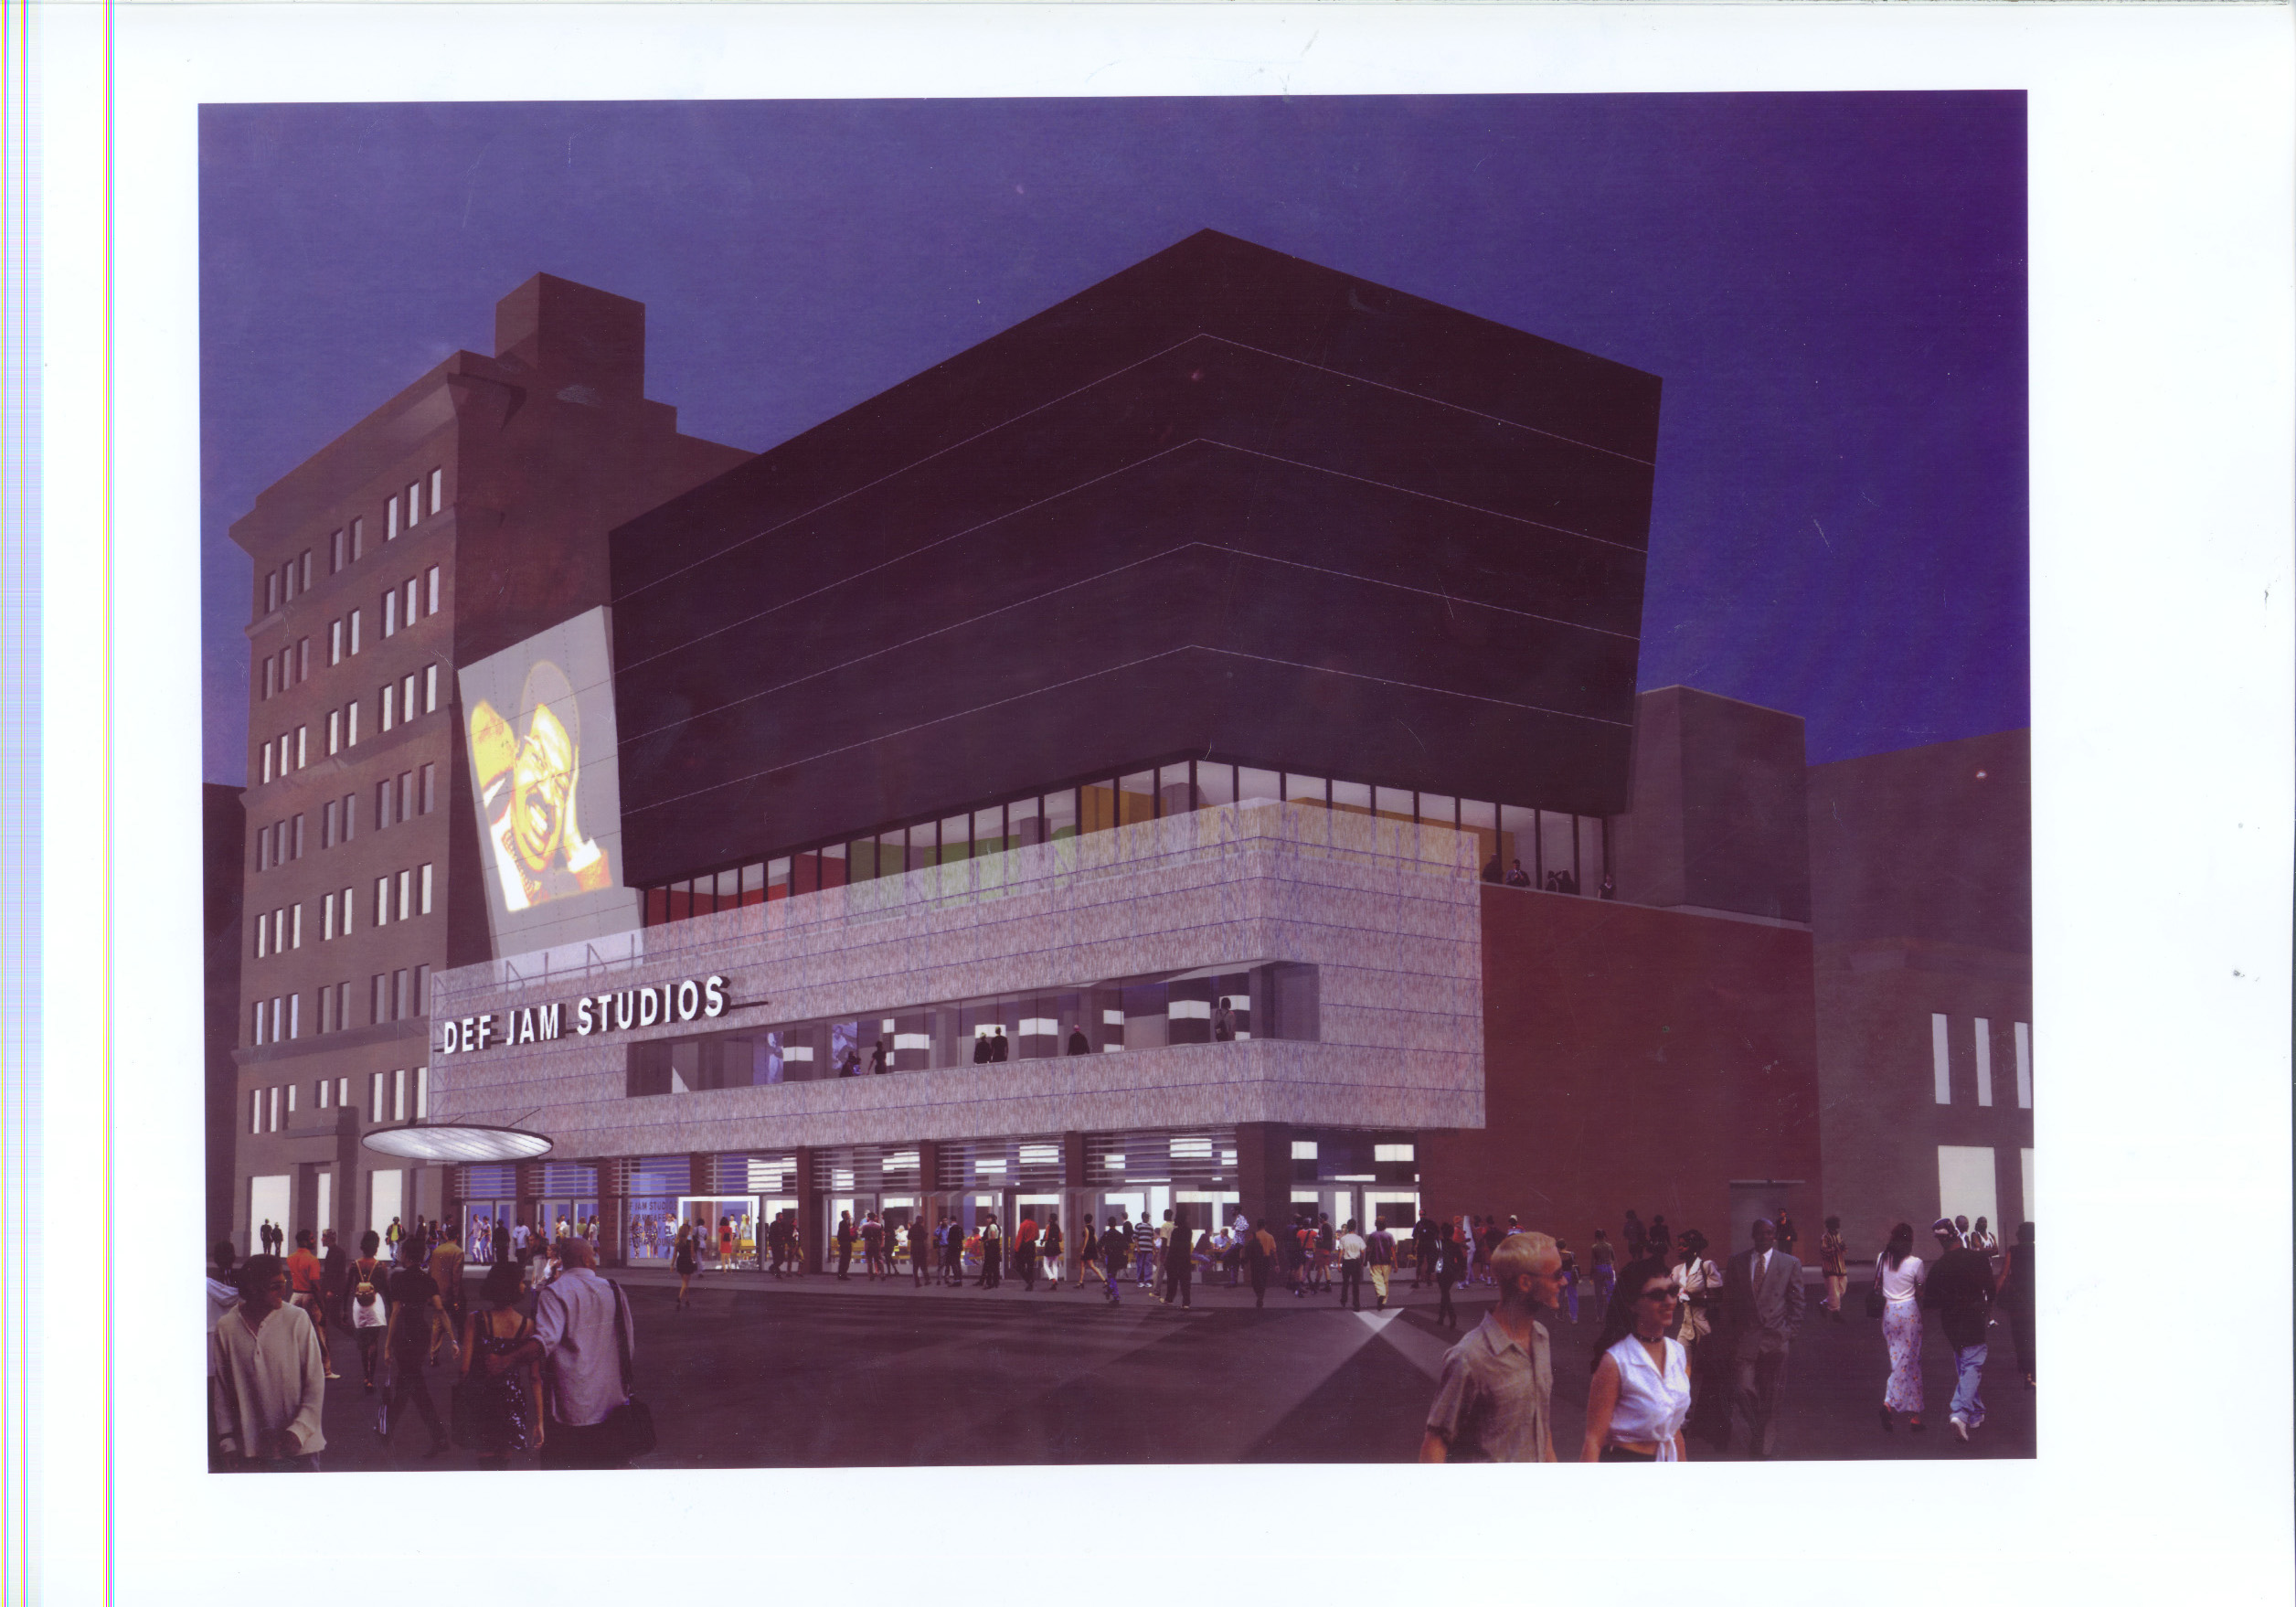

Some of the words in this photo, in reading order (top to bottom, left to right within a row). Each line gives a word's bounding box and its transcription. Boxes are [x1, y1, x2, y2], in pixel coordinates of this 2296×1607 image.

[443, 1015, 493, 1055] DEF
[506, 1003, 558, 1046] JAM
[577, 974, 725, 1037] STUDIOS
